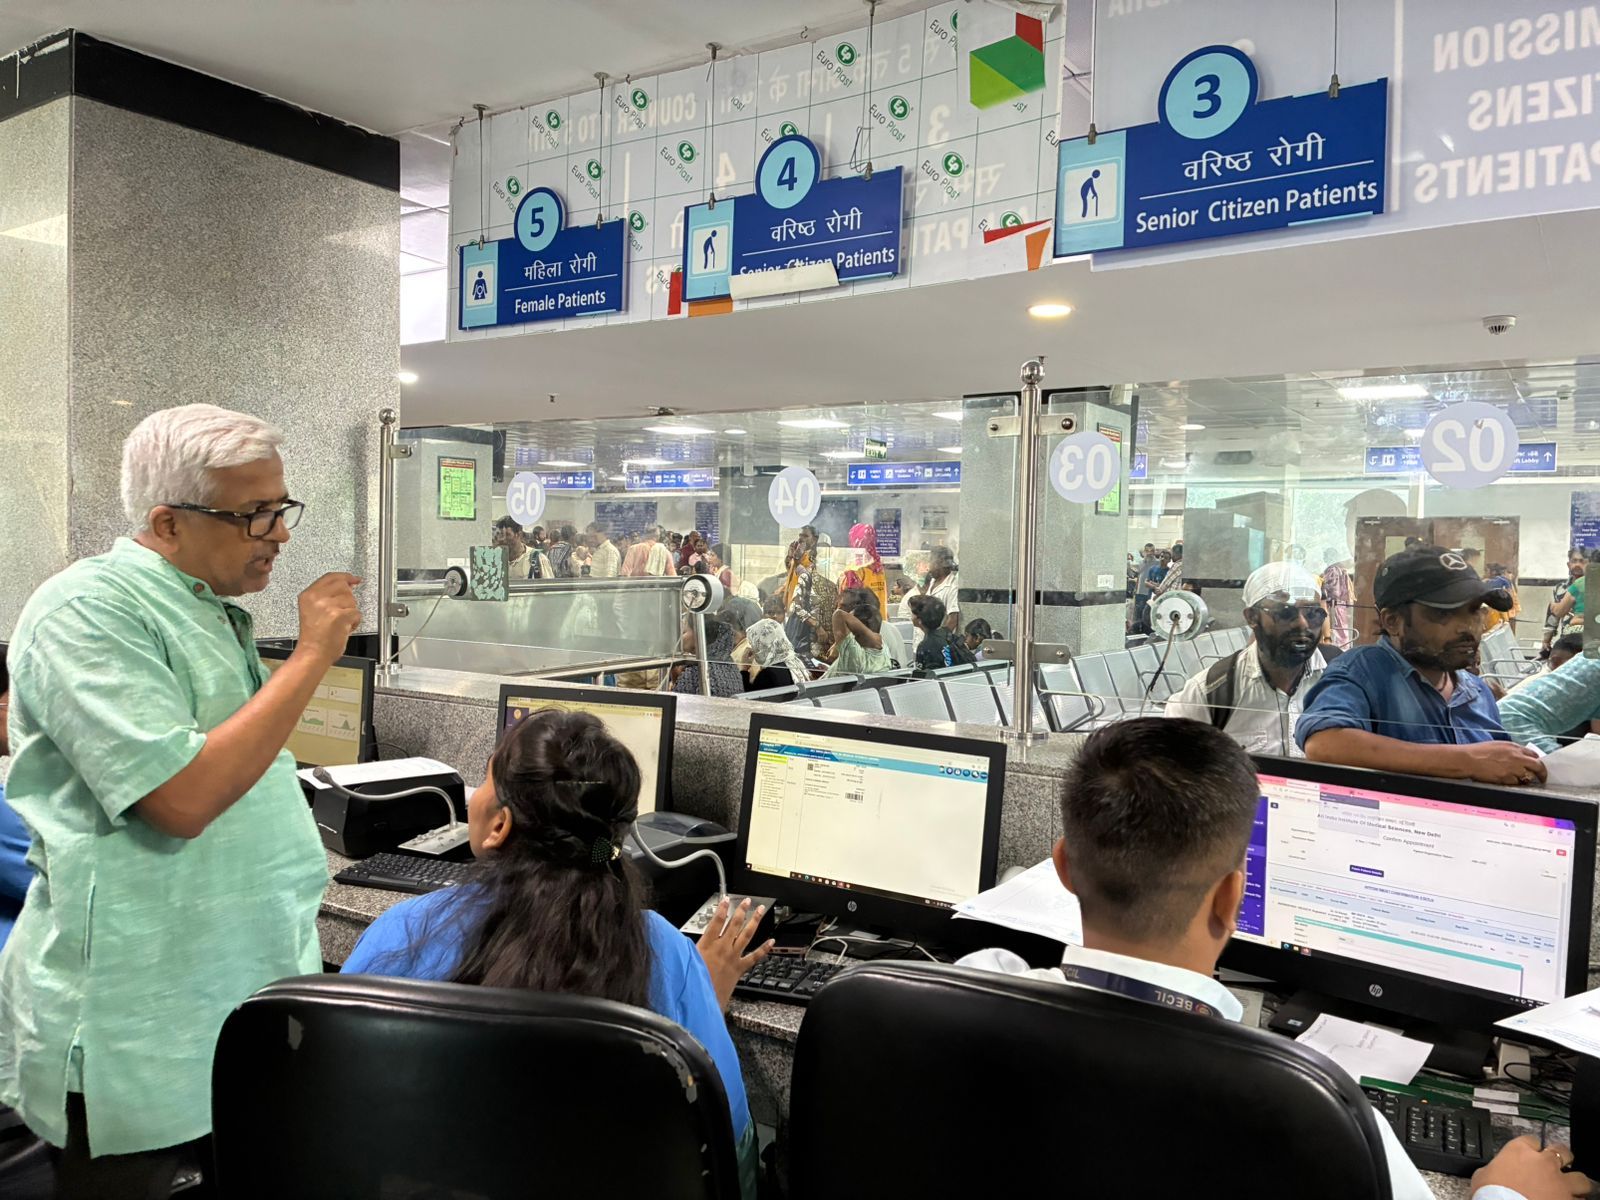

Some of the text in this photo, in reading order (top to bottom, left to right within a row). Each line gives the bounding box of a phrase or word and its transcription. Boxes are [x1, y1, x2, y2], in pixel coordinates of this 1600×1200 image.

[929, 19, 948, 40] Euro
[816, 50, 834, 70] Euro
[834, 66, 853, 88] Plast
[615, 95, 646, 129] Euro Plast
[1193, 74, 1222, 119] 3
[532, 116, 545, 133] Euro
[545, 130, 559, 149] Plast
[869, 103, 906, 142] Euro Plast
[660, 146, 693, 183] Euro Plast
[1181, 132, 1326, 181] वरिष्ठ रोगी
[493, 181, 505, 199] Euro
[571, 165, 600, 199] Euro Plast
[777, 157, 798, 192] 4
[921, 160, 939, 181] Euro
[940, 178, 960, 200] Plast
[530, 206, 545, 238] 5
[1136, 181, 1378, 233] Senior Citizen Patients
[770, 207, 863, 242] वरिष्ठ रोगी
[524, 252, 597, 281] महिला रोगी
[837, 248, 895, 269] Patients
[514, 289, 606, 315] Female Patients
[1154, 989, 1193, 1012] BECIL
